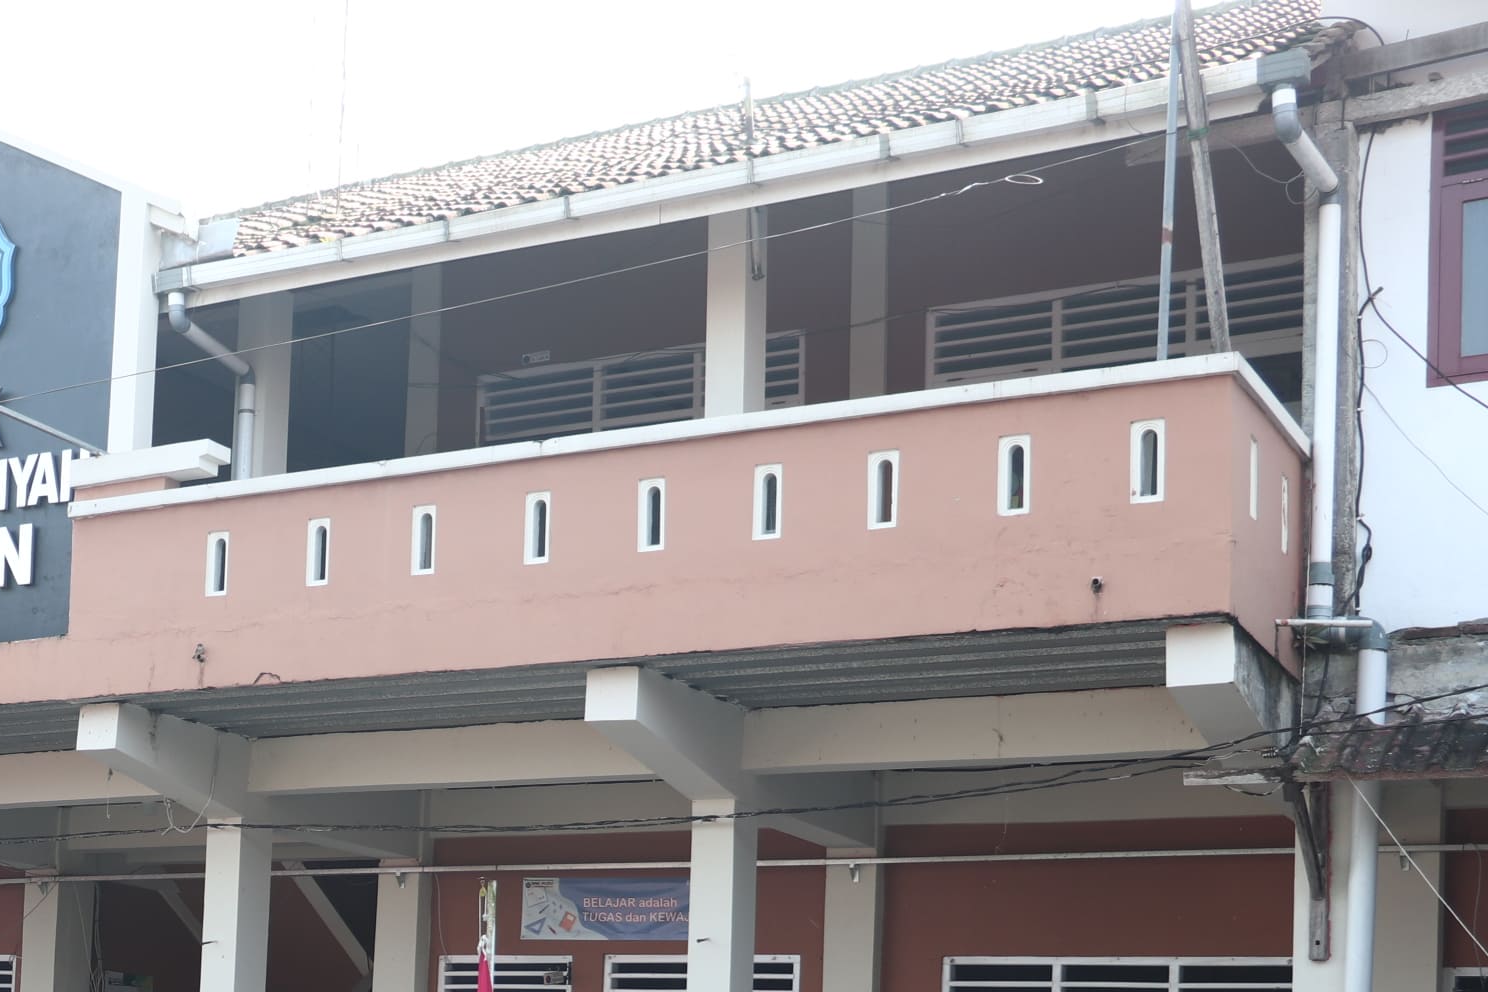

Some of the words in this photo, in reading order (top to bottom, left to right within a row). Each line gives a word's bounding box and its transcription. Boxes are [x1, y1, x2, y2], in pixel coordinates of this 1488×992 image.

[583, 898, 636, 908] BELAJAR
[639, 898, 677, 908] adalah
[582, 911, 622, 922] TUGAS
[625, 912, 646, 922] dan
